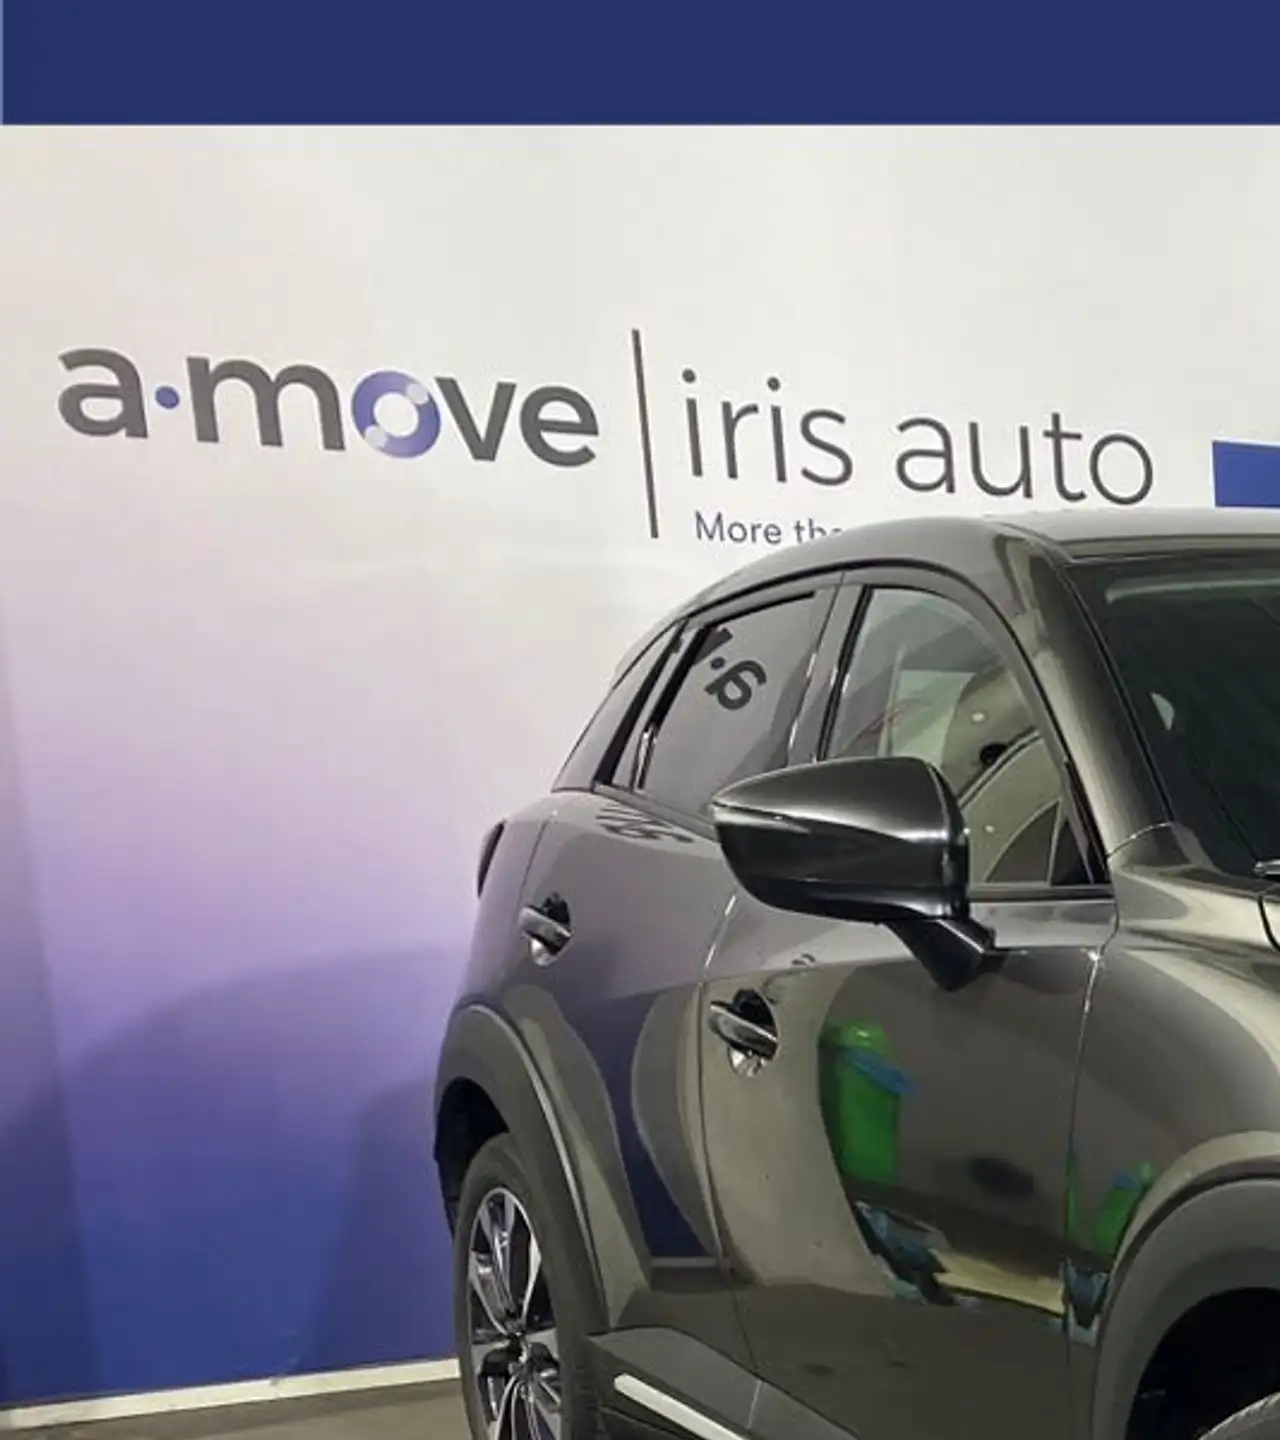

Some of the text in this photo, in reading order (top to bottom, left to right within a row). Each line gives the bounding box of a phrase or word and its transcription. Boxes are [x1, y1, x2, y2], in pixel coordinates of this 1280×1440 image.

[682, 369, 853, 486] iris
[896, 412, 1153, 506] auto
[695, 509, 782, 544] More
